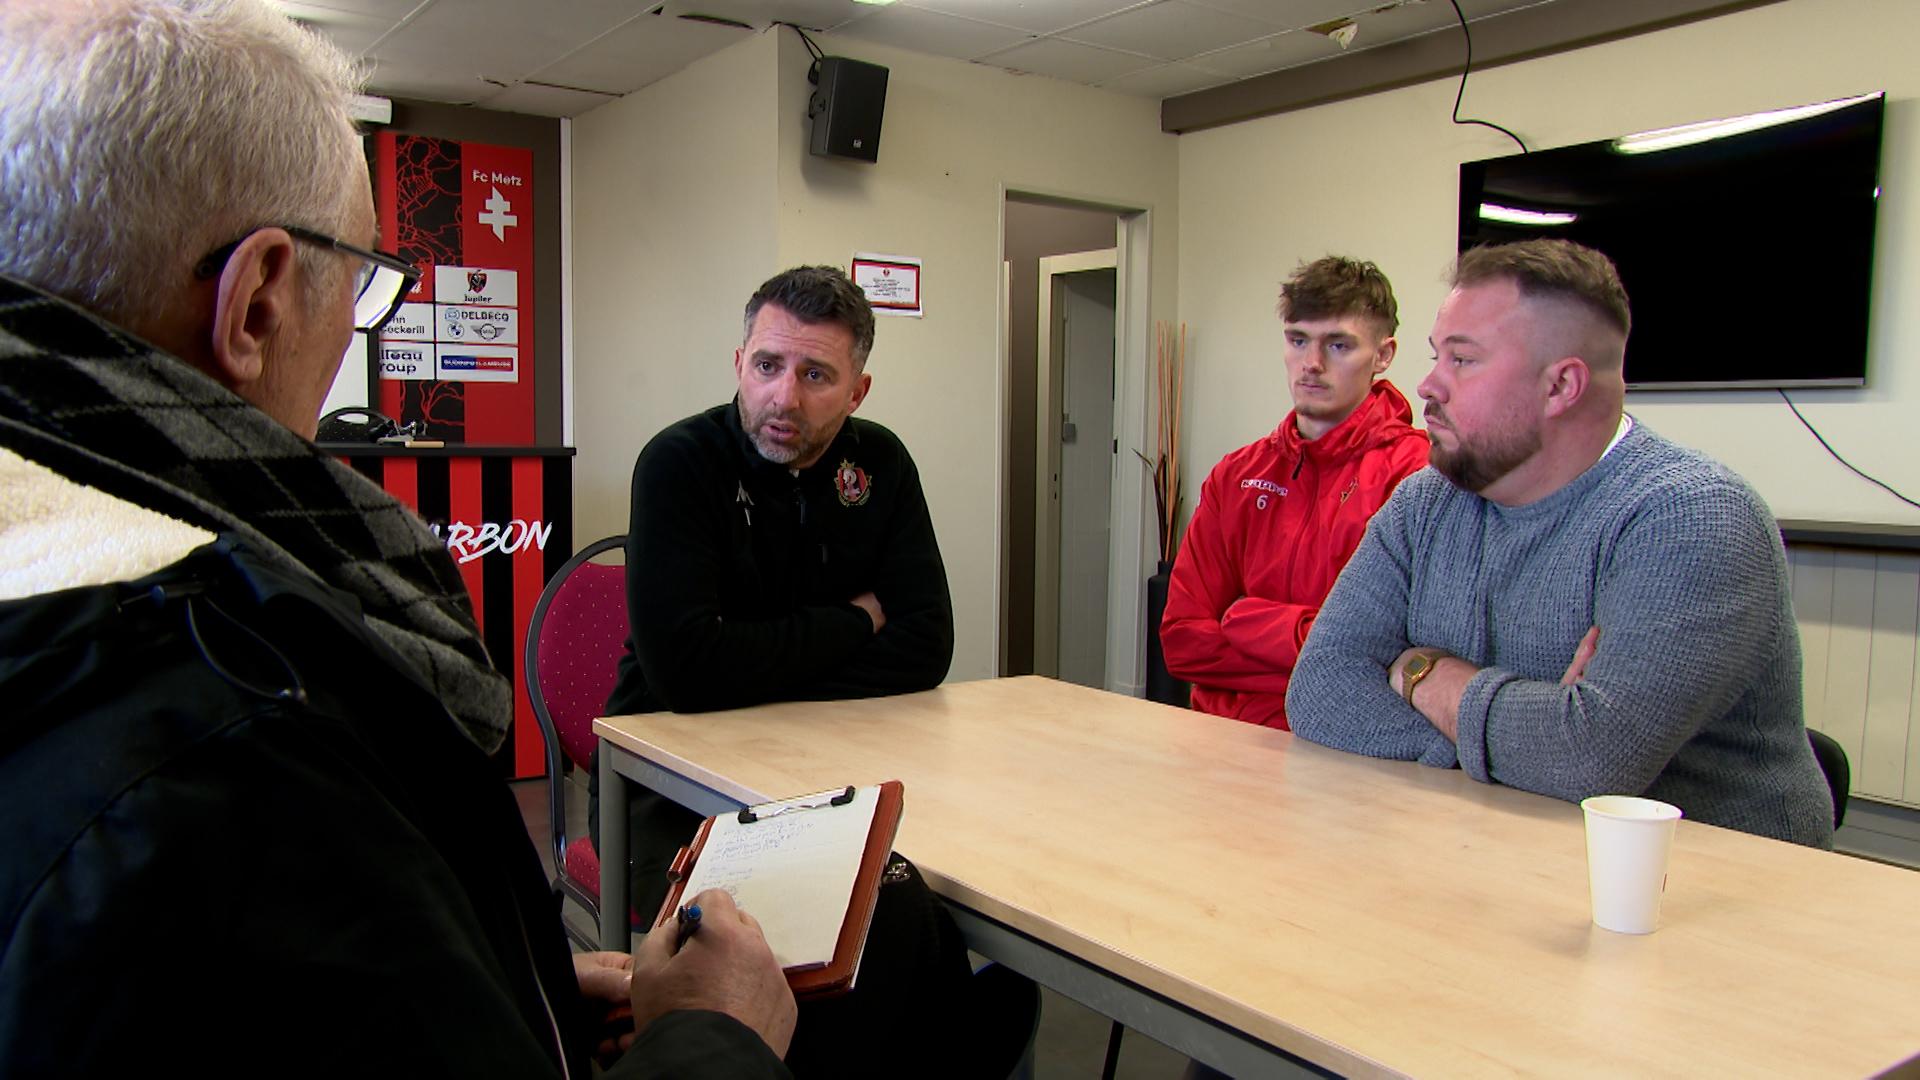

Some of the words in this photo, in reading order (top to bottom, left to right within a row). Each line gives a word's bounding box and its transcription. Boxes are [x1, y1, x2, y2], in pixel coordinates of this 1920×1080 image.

[472, 169, 489, 182] Fc
[491, 171, 523, 186] Metz
[464, 294, 493, 304] Jupiler
[461, 311, 510, 322] DELBECQ
[380, 363, 417, 375] roup
[1256, 494, 1269, 510] 6
[429, 519, 553, 564] RBON
